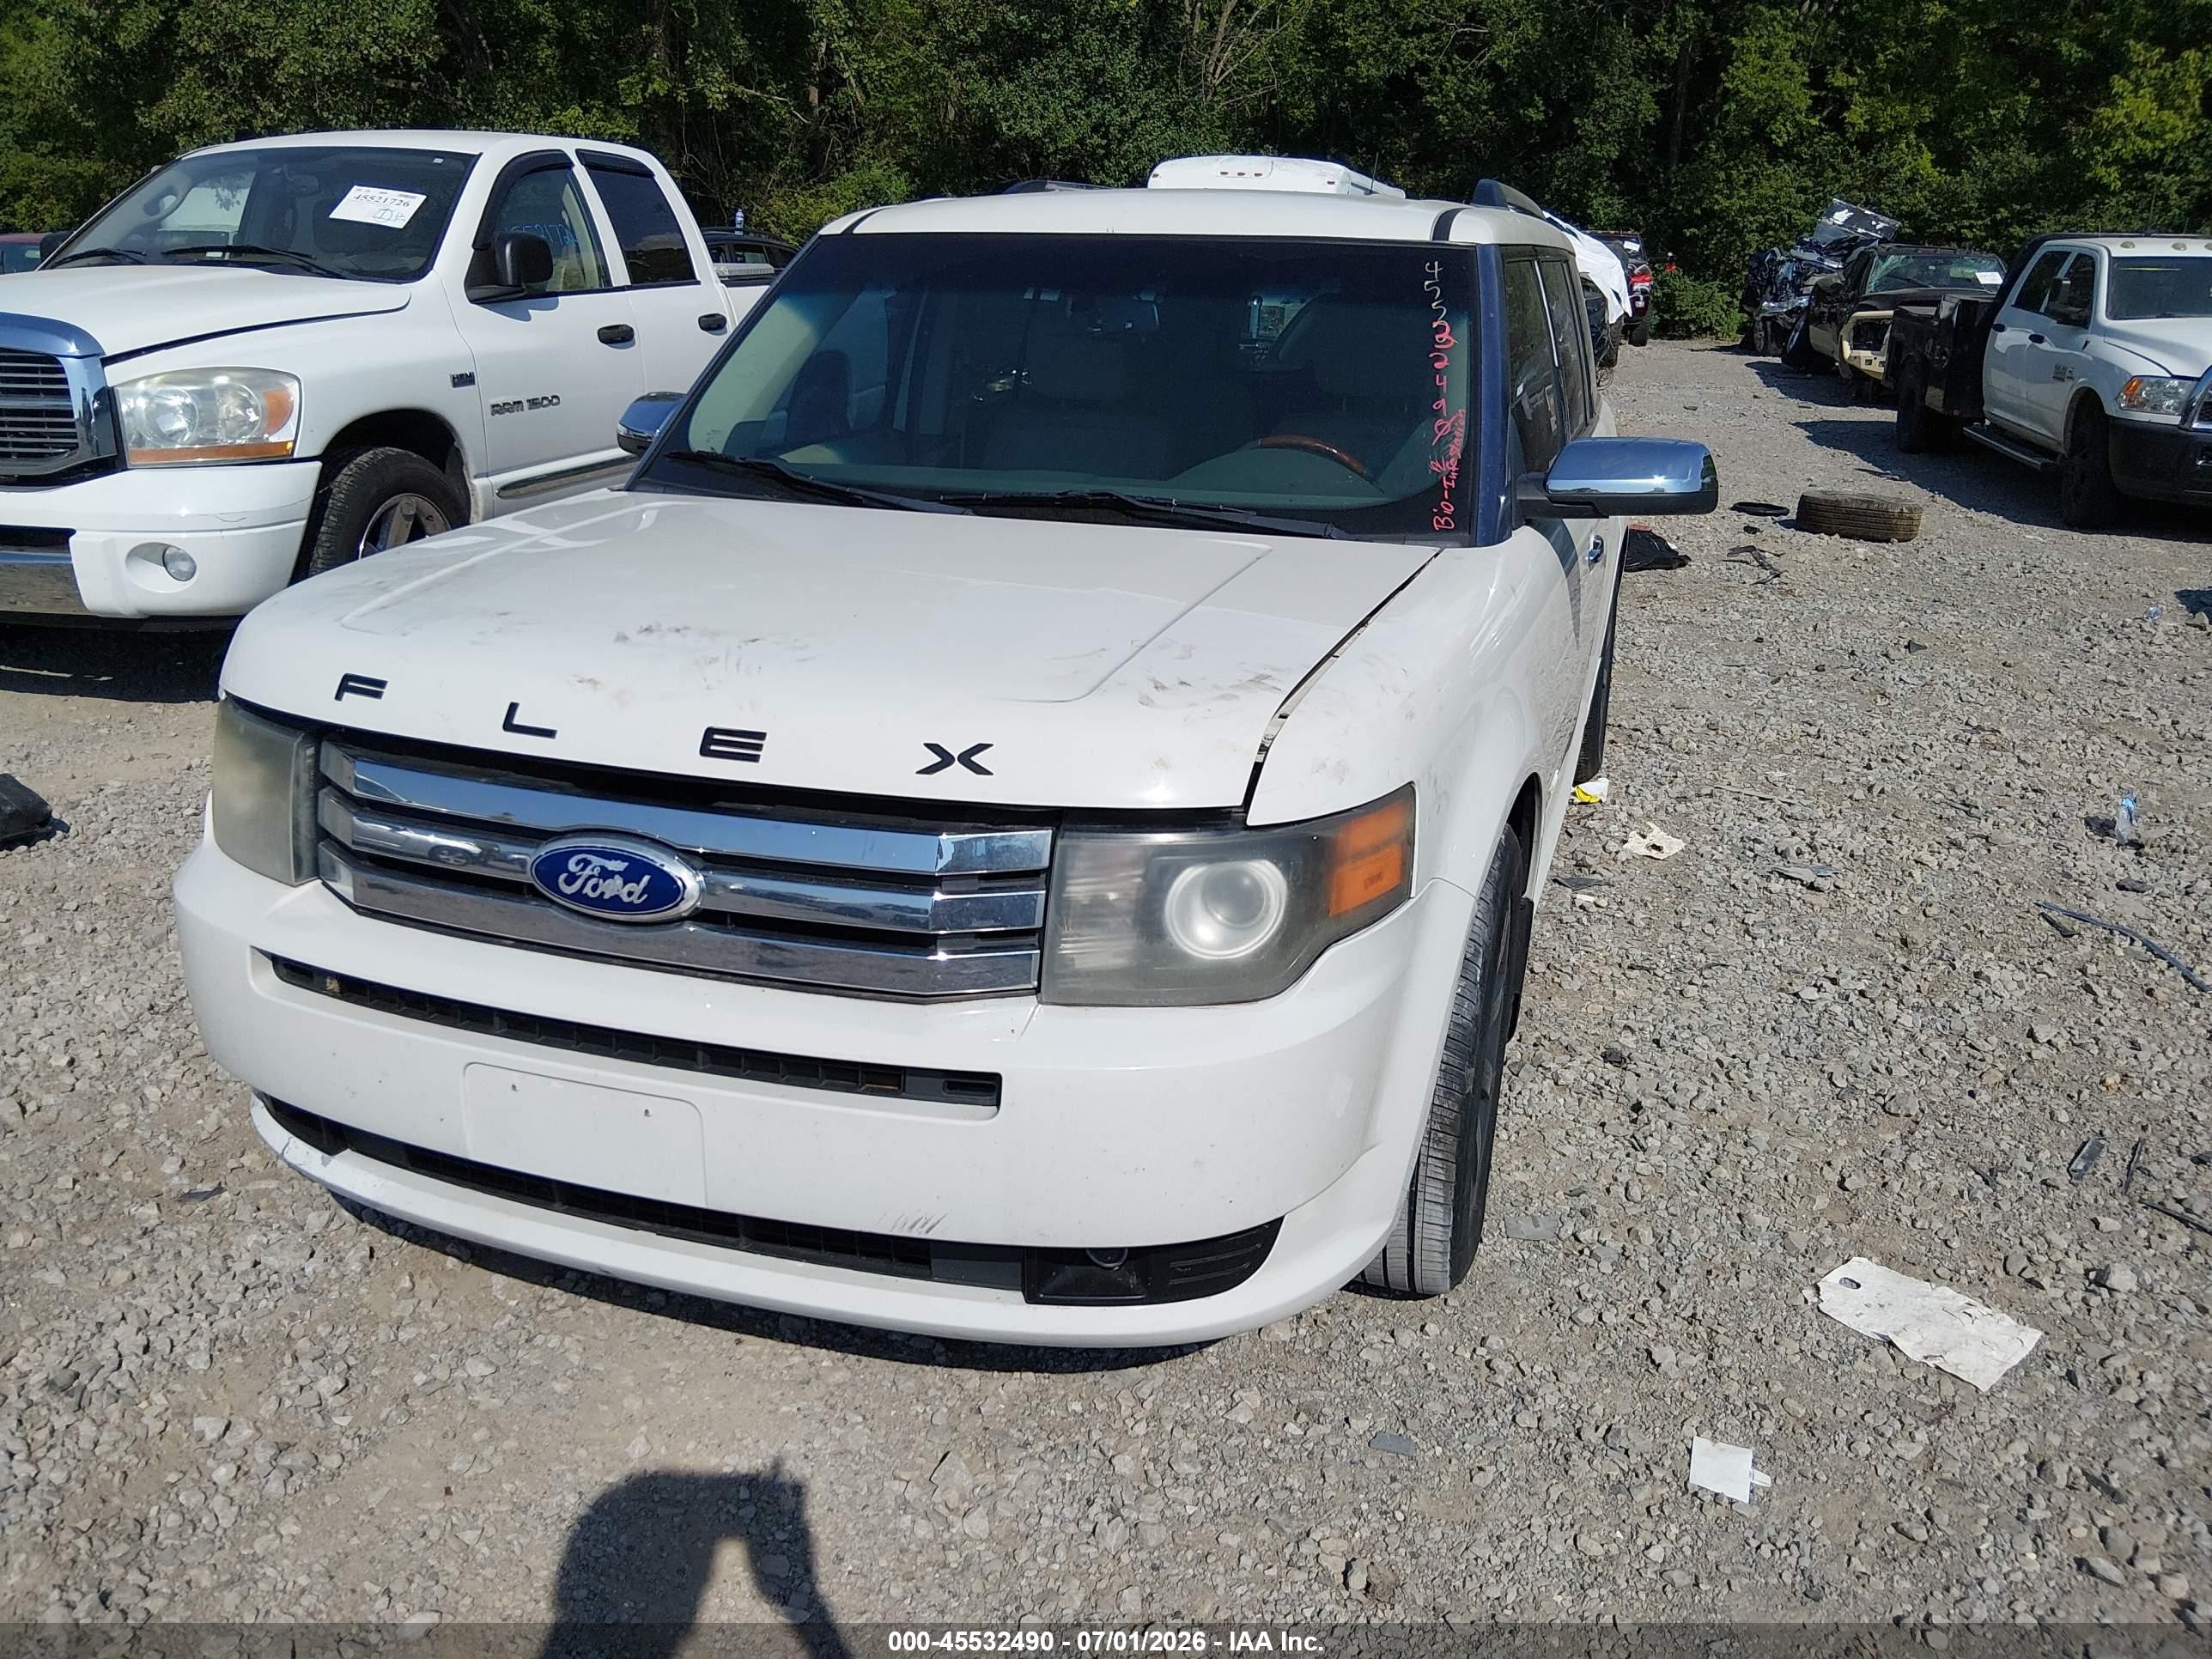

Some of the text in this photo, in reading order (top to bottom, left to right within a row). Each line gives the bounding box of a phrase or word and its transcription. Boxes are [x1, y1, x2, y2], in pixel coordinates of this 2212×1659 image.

[353, 193, 410, 208] 45521726
[490, 394, 561, 416] RAM 1500
[335, 673, 994, 776] FLEX
[558, 853, 652, 904] Ford
